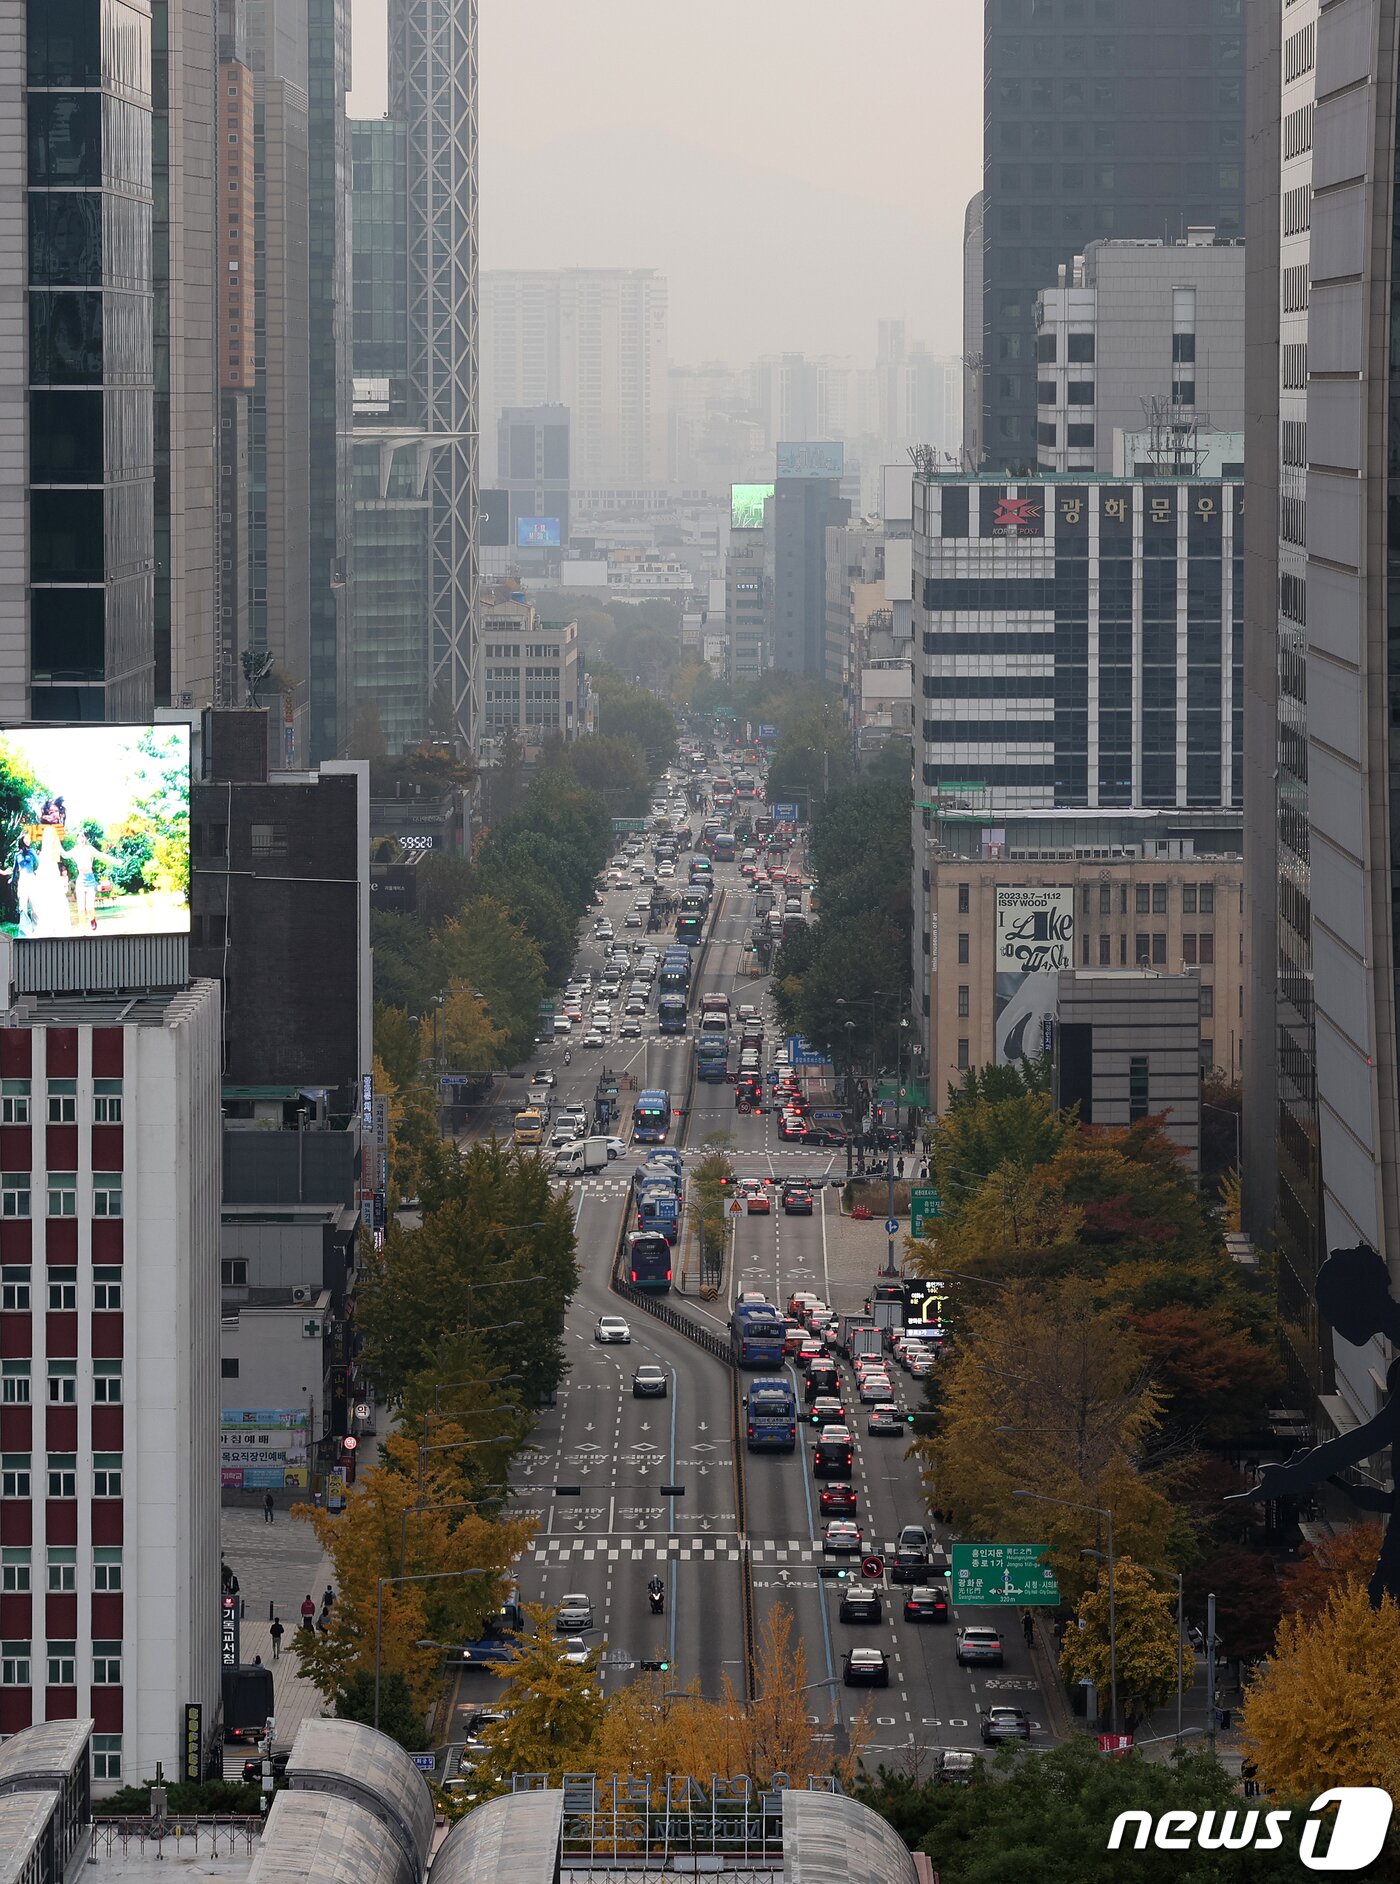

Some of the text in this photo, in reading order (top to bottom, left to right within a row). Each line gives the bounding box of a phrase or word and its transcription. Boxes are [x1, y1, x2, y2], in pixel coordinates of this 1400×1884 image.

[1060, 498, 1244, 523] 광화문우
[998, 899, 1048, 907] ISSY WOOD
[998, 911, 1005, 927] I
[972, 1549, 1003, 1558] 흥인지문
[958, 1579, 983, 1587] 광화문
[223, 1609, 235, 1665] 기독교서점
